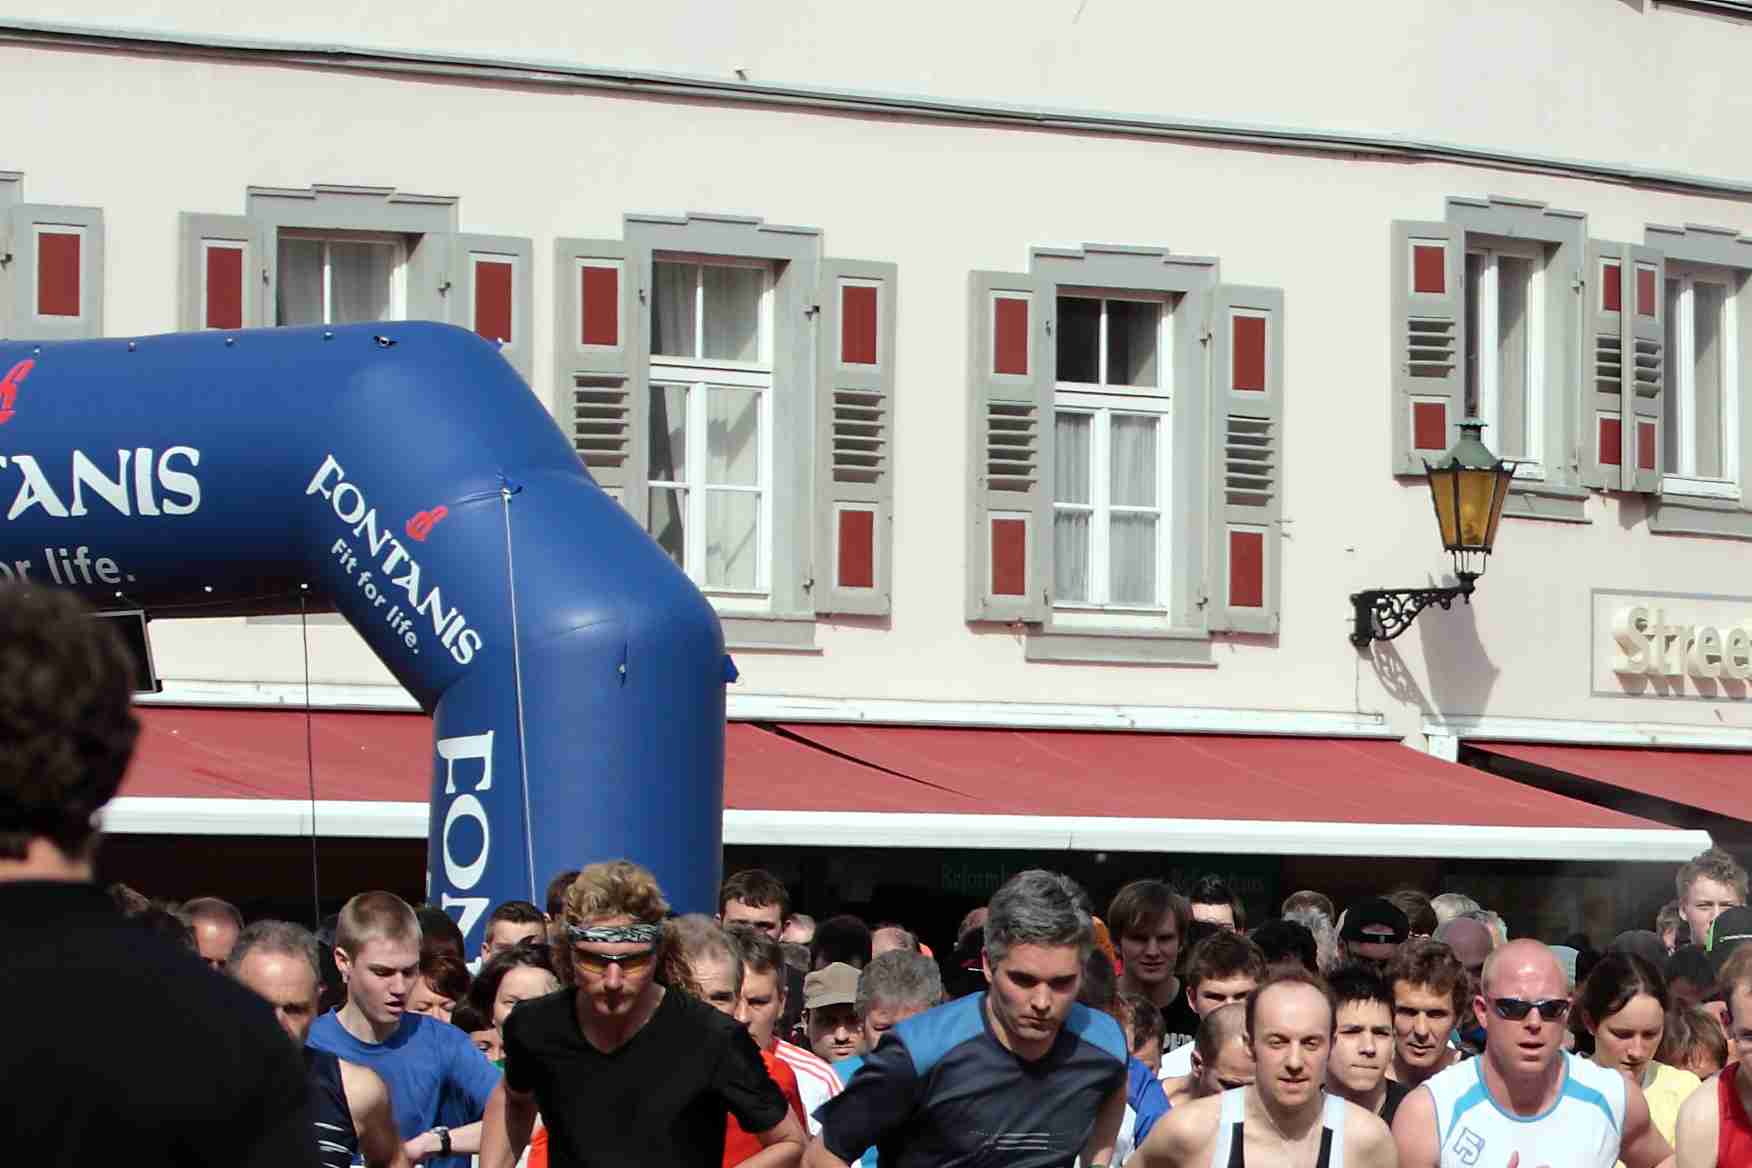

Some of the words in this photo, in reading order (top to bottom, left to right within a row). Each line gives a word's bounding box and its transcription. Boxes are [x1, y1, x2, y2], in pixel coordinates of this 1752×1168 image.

[0, 446, 202, 520] ANIS
[44, 546, 137, 585] life.
[305, 453, 483, 665] FONTANIS
[331, 538, 357, 574] Fit
[357, 571, 387, 608] for
[386, 605, 420, 655] life.
